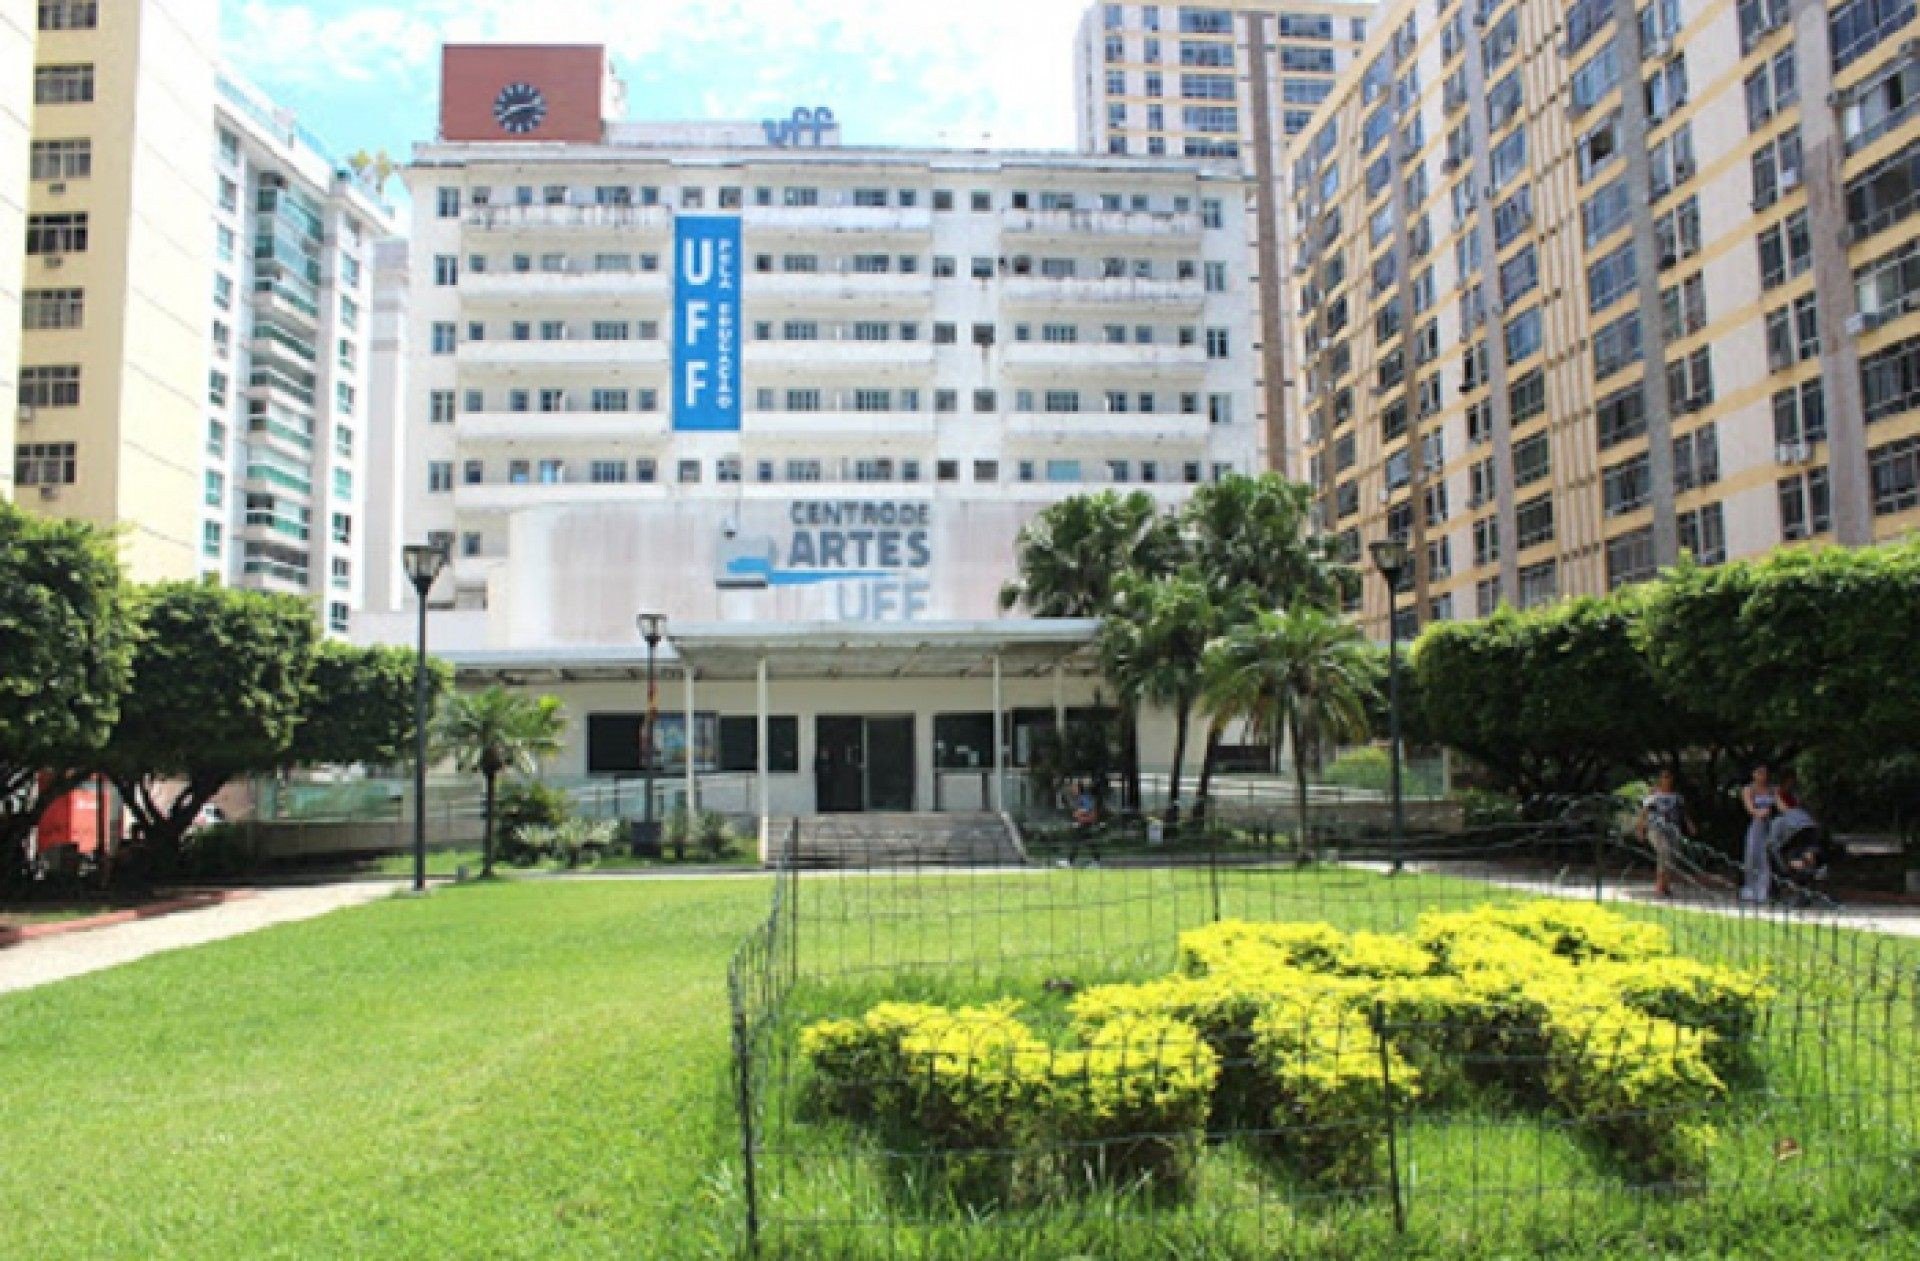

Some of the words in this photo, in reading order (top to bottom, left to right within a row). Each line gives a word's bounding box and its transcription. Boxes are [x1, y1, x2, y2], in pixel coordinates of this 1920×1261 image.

[683, 238, 713, 408] UFF
[789, 530, 931, 567] ARTES
[838, 582, 930, 620] UFF
